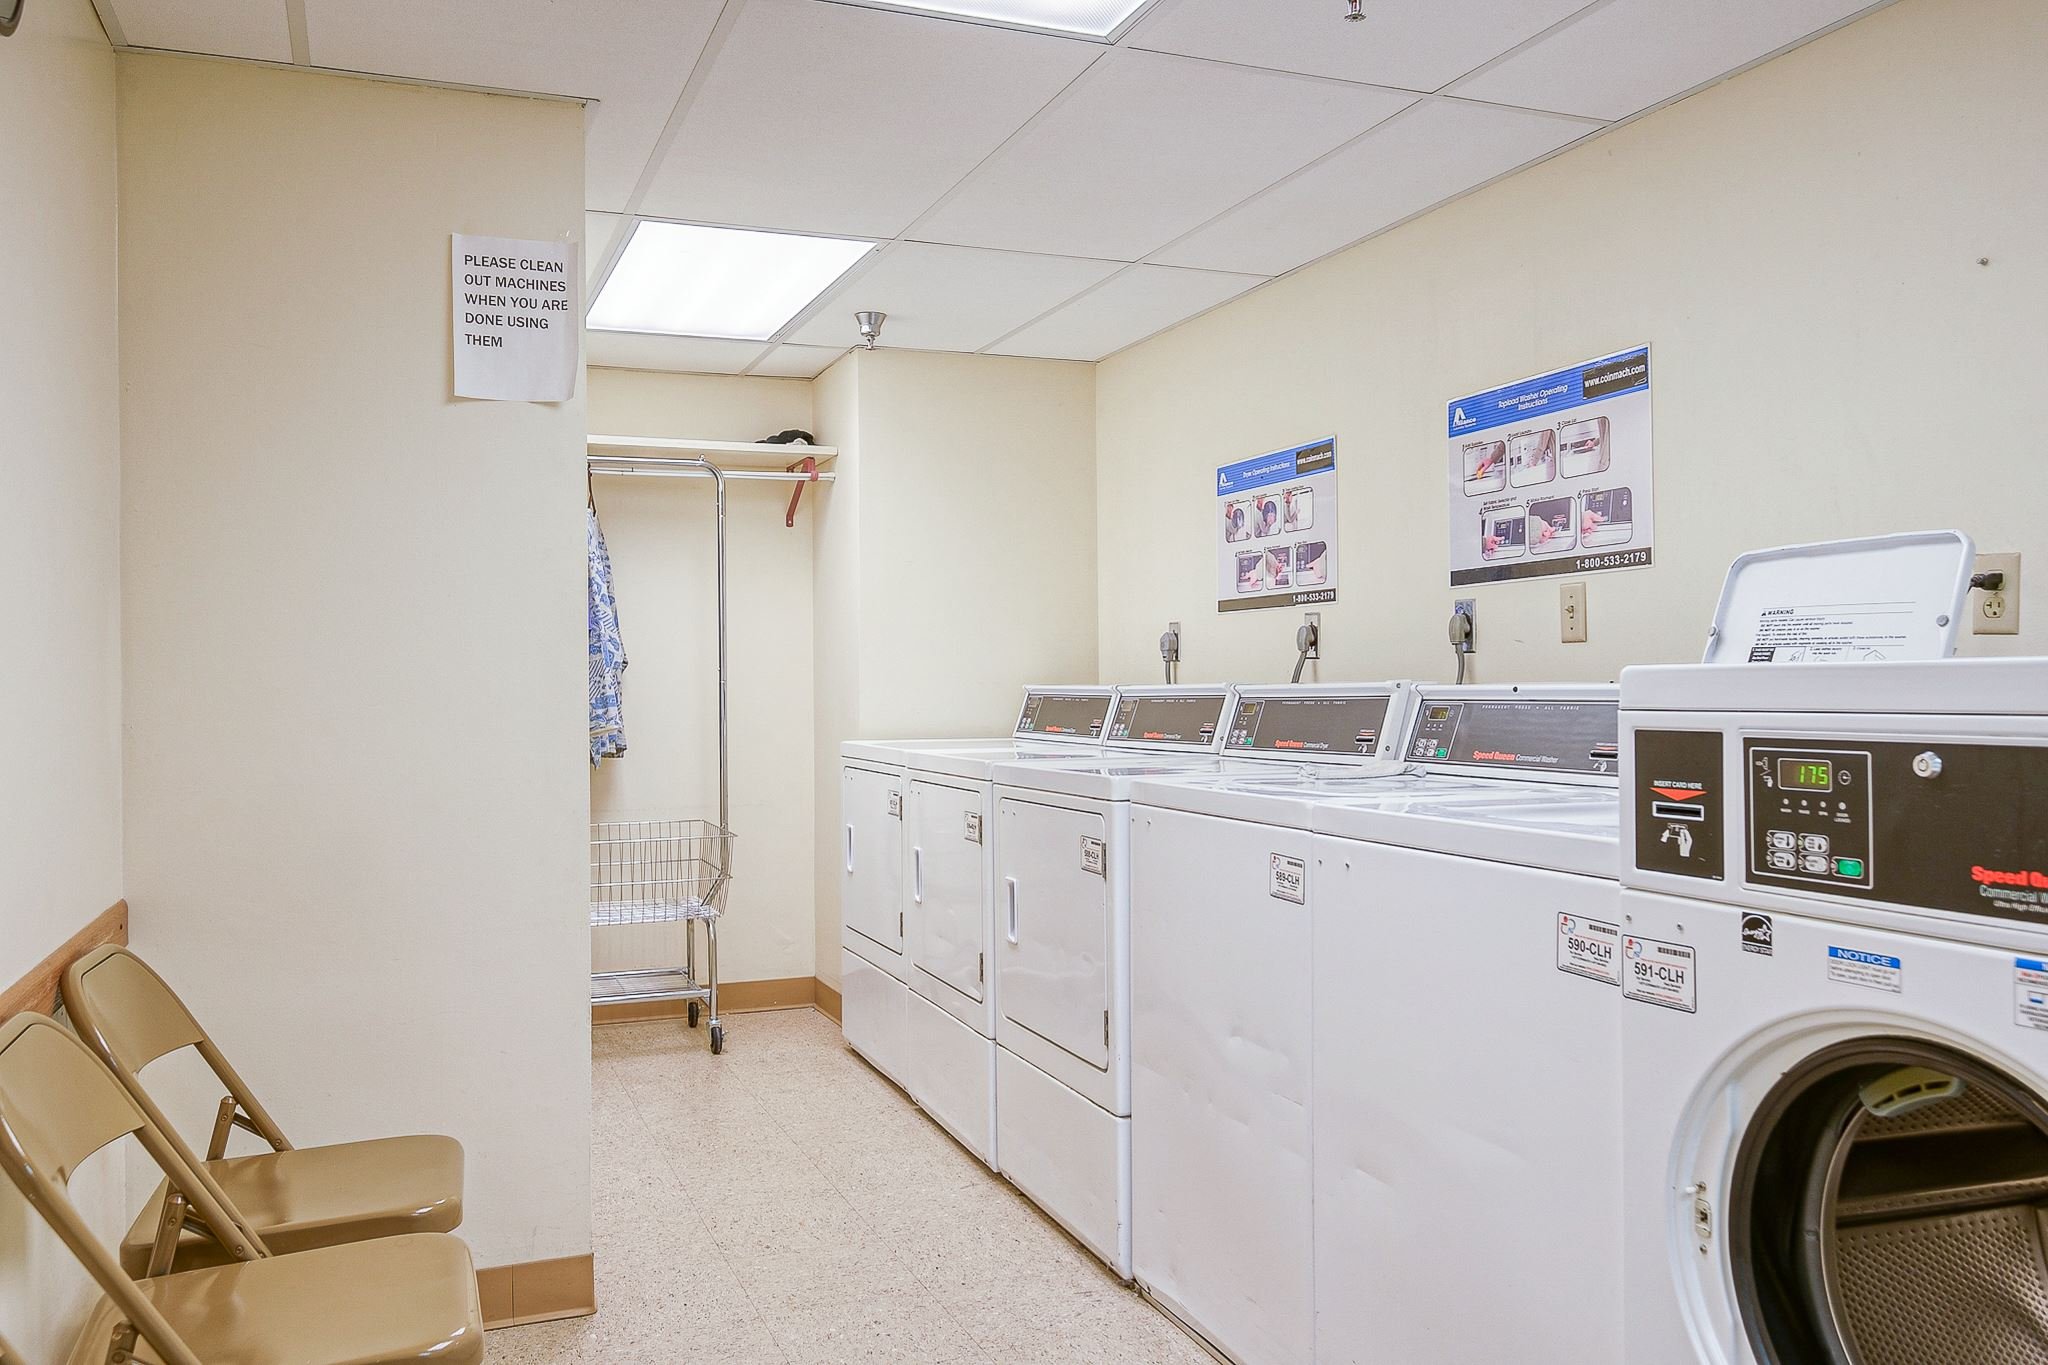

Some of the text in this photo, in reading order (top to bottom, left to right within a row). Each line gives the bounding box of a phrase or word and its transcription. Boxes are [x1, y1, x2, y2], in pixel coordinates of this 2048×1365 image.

[464, 254, 564, 273] PLEASE CLEAN
[464, 274, 566, 292] OUT MACHINES
[464, 293, 568, 311] WHEN YOU ARE
[465, 312, 549, 329] DONE USING
[465, 333, 503, 347] THEM
[1584, 365, 1646, 388] www.coinmach.com
[1497, 384, 1569, 409] Topload Washer Operating
[1575, 551, 1647, 570] 1-800-533-2179
[1767, 608, 1795, 616] WARNING
[1473, 750, 1494, 761] Speed
[1494, 751, 1515, 761] Queen
[1799, 765, 1829, 785] 175
[1971, 865, 2029, 887] Speed
[1979, 884, 2038, 903] Commercial
[1567, 937, 1612, 960] 590-CLH
[1837, 949, 1892, 967] NOTICE
[1634, 961, 1684, 985] 591-CLH
